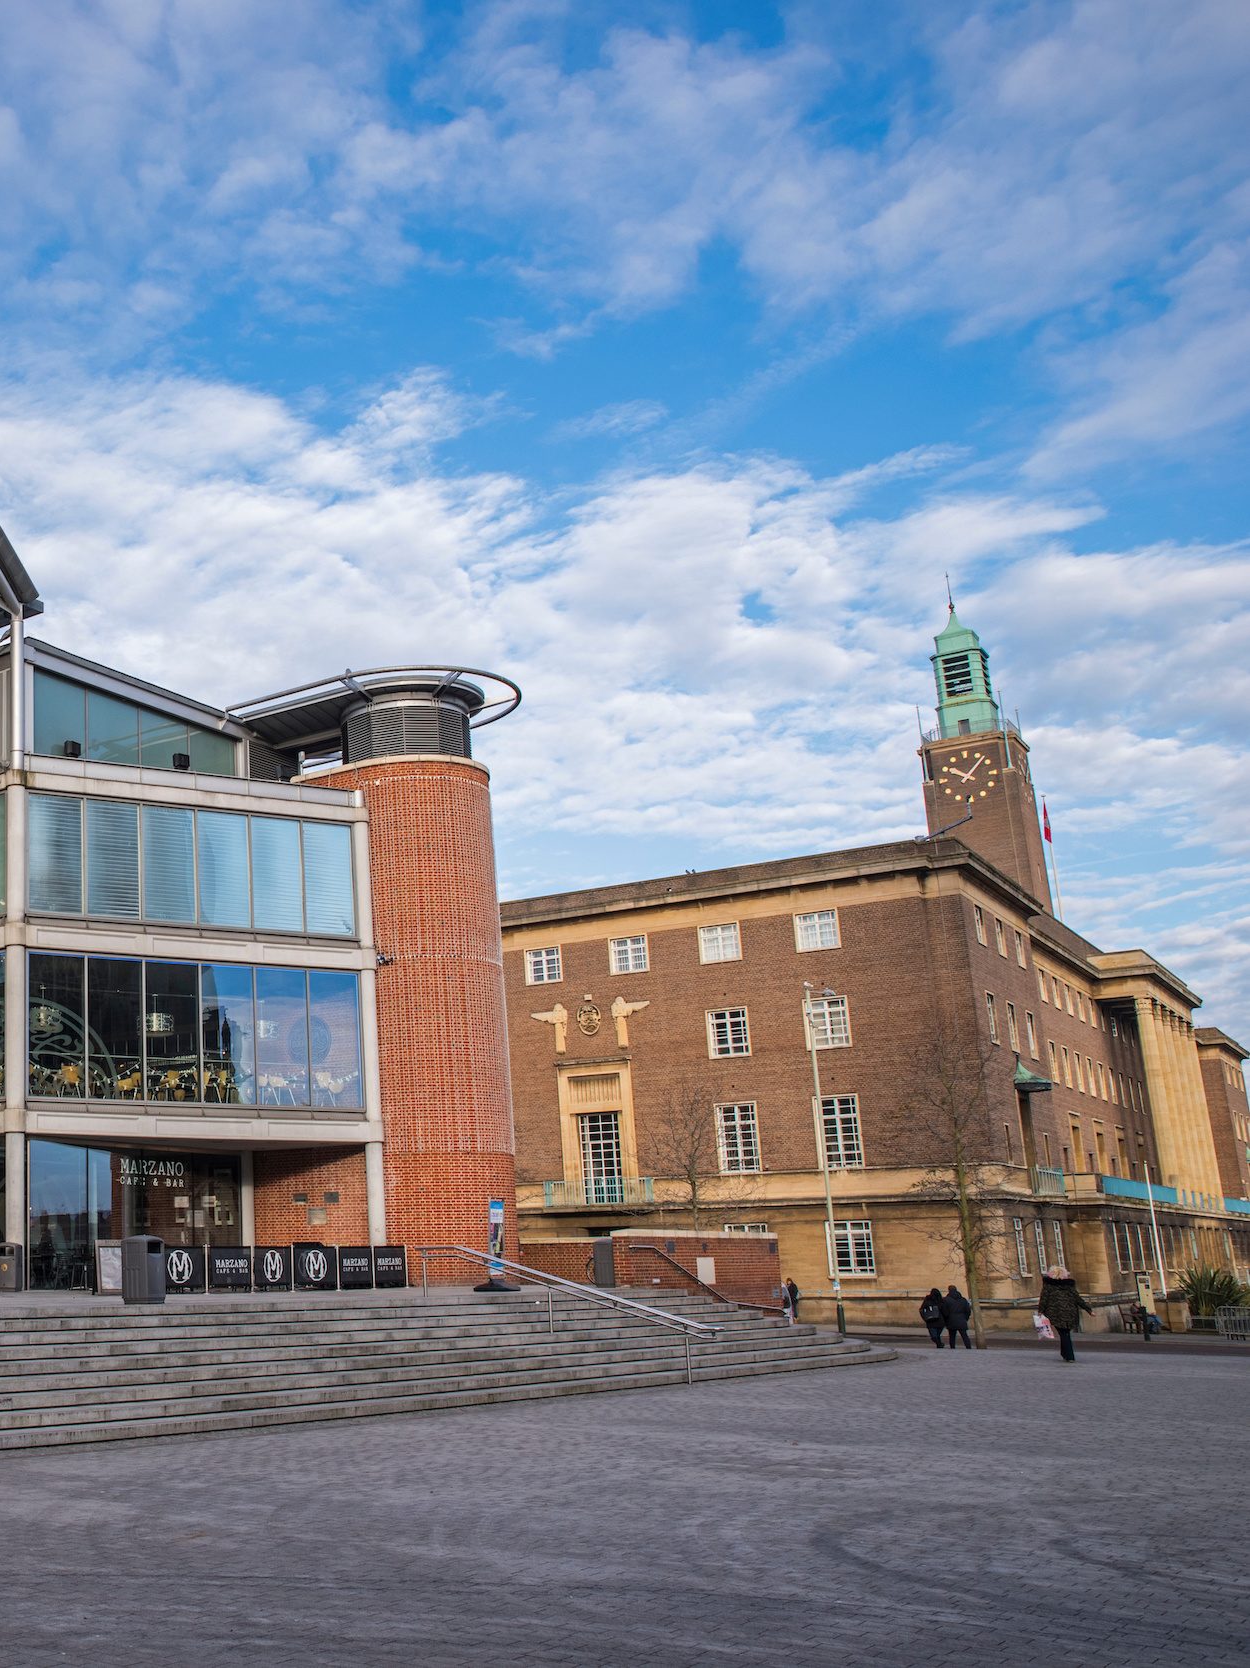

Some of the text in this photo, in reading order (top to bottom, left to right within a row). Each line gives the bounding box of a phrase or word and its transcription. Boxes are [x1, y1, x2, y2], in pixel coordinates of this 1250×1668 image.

[119, 1158, 184, 1177] MARZANO
[152, 1178, 159, 1187] &
[165, 1178, 185, 1188] BAR
[215, 1258, 249, 1269] MARZANO
[342, 1257, 369, 1267] MARZANO
[376, 1256, 403, 1266] MARZANO
